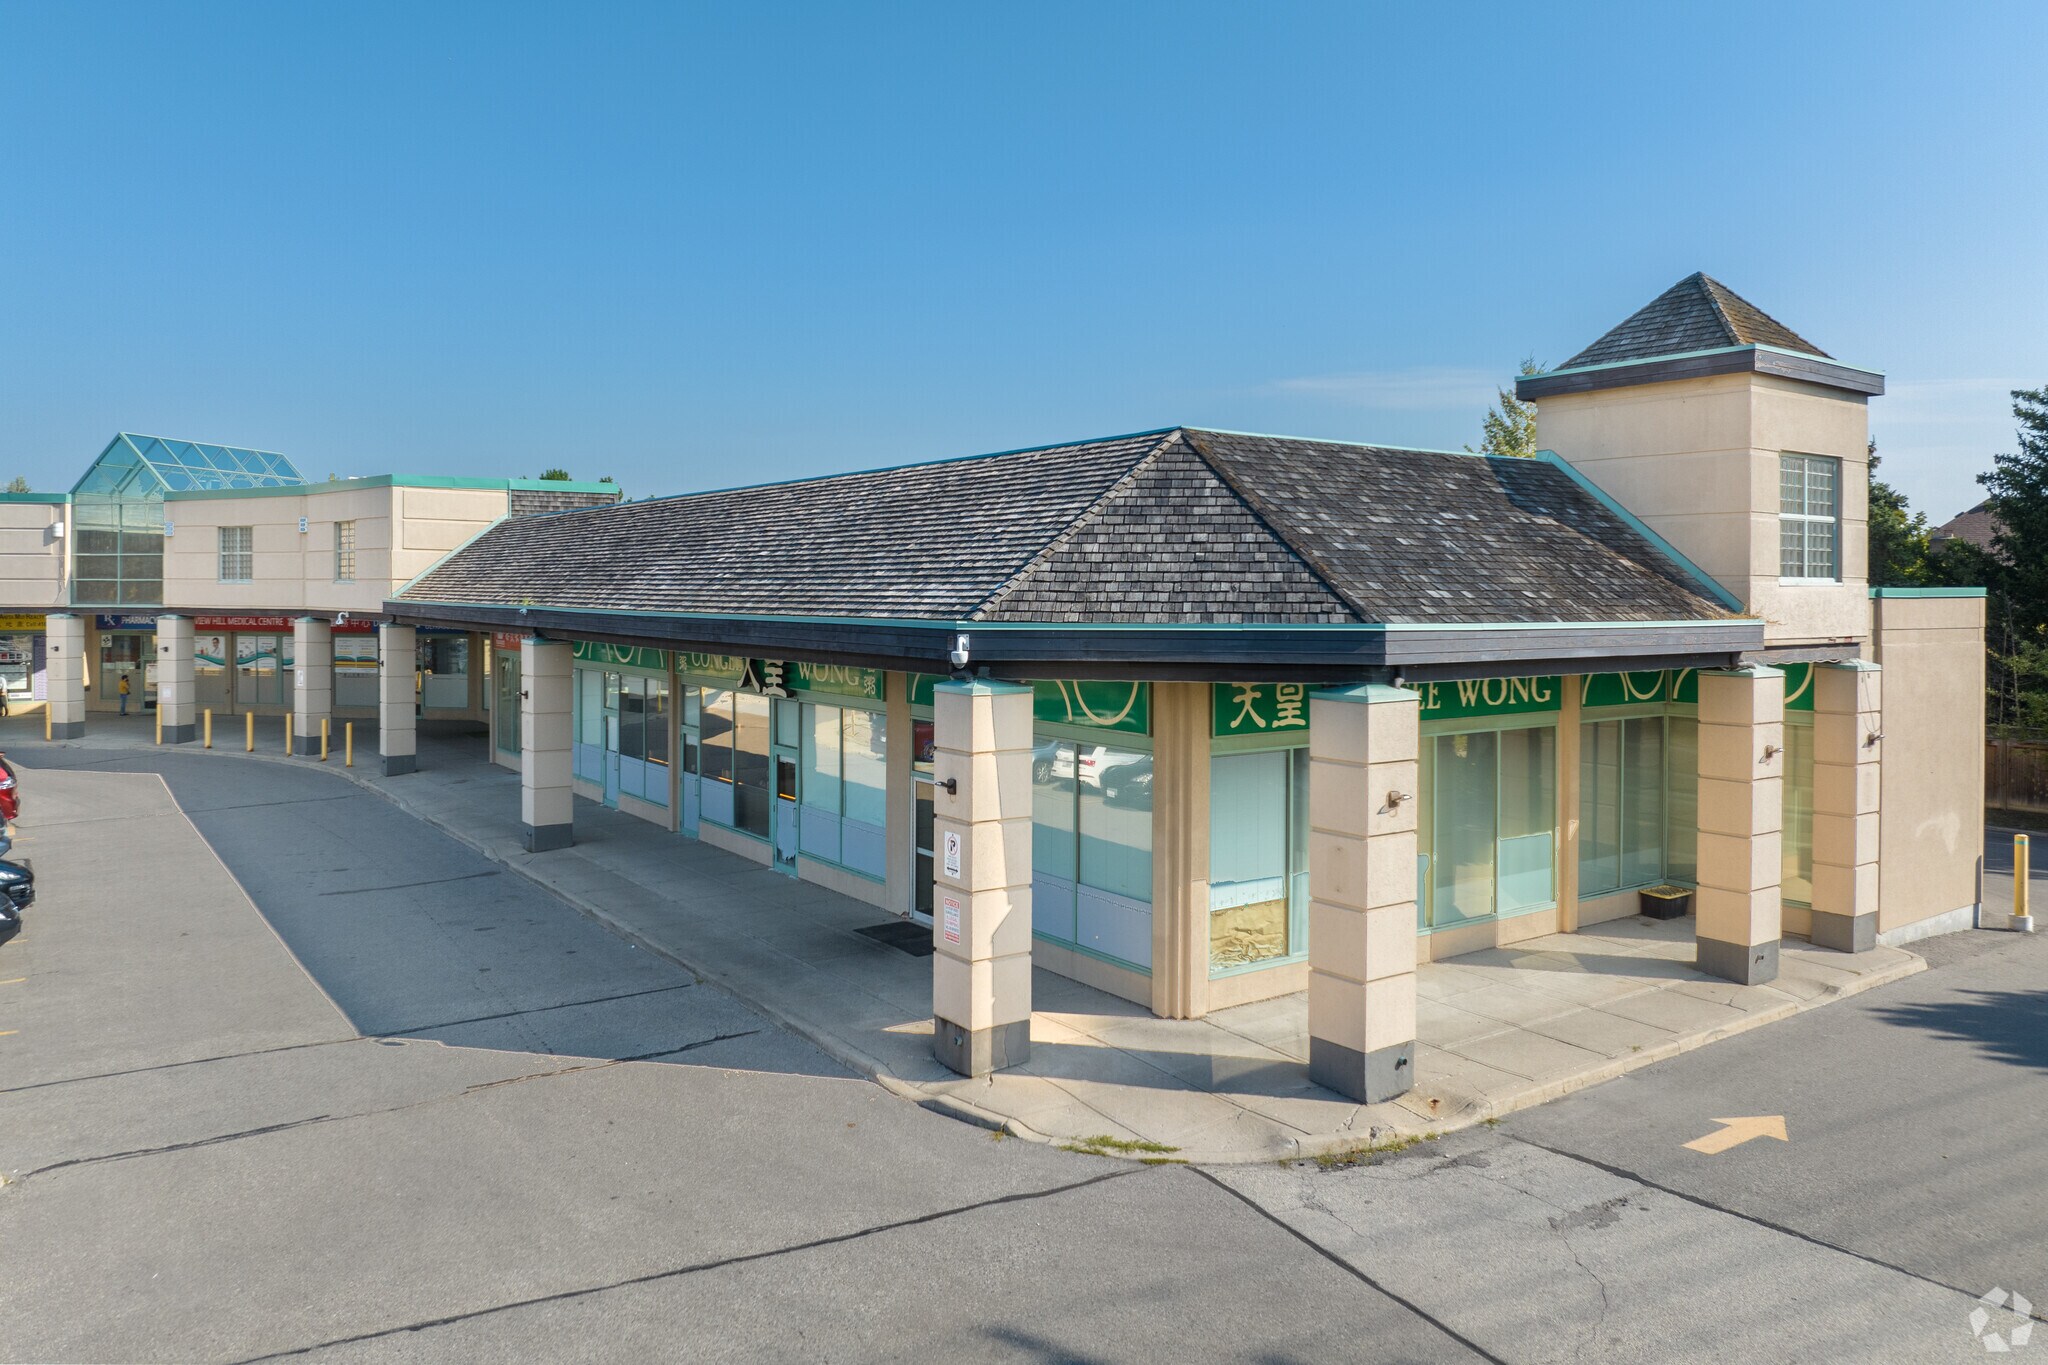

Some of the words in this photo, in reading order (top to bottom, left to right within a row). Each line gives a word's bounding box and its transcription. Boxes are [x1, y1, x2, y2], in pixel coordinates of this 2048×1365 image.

[212, 616, 226, 625] HILL
[228, 616, 257, 626] MEDICAL
[258, 617, 284, 626] CENTRE
[798, 660, 860, 686] WONG
[1457, 675, 1552, 708] WONG
